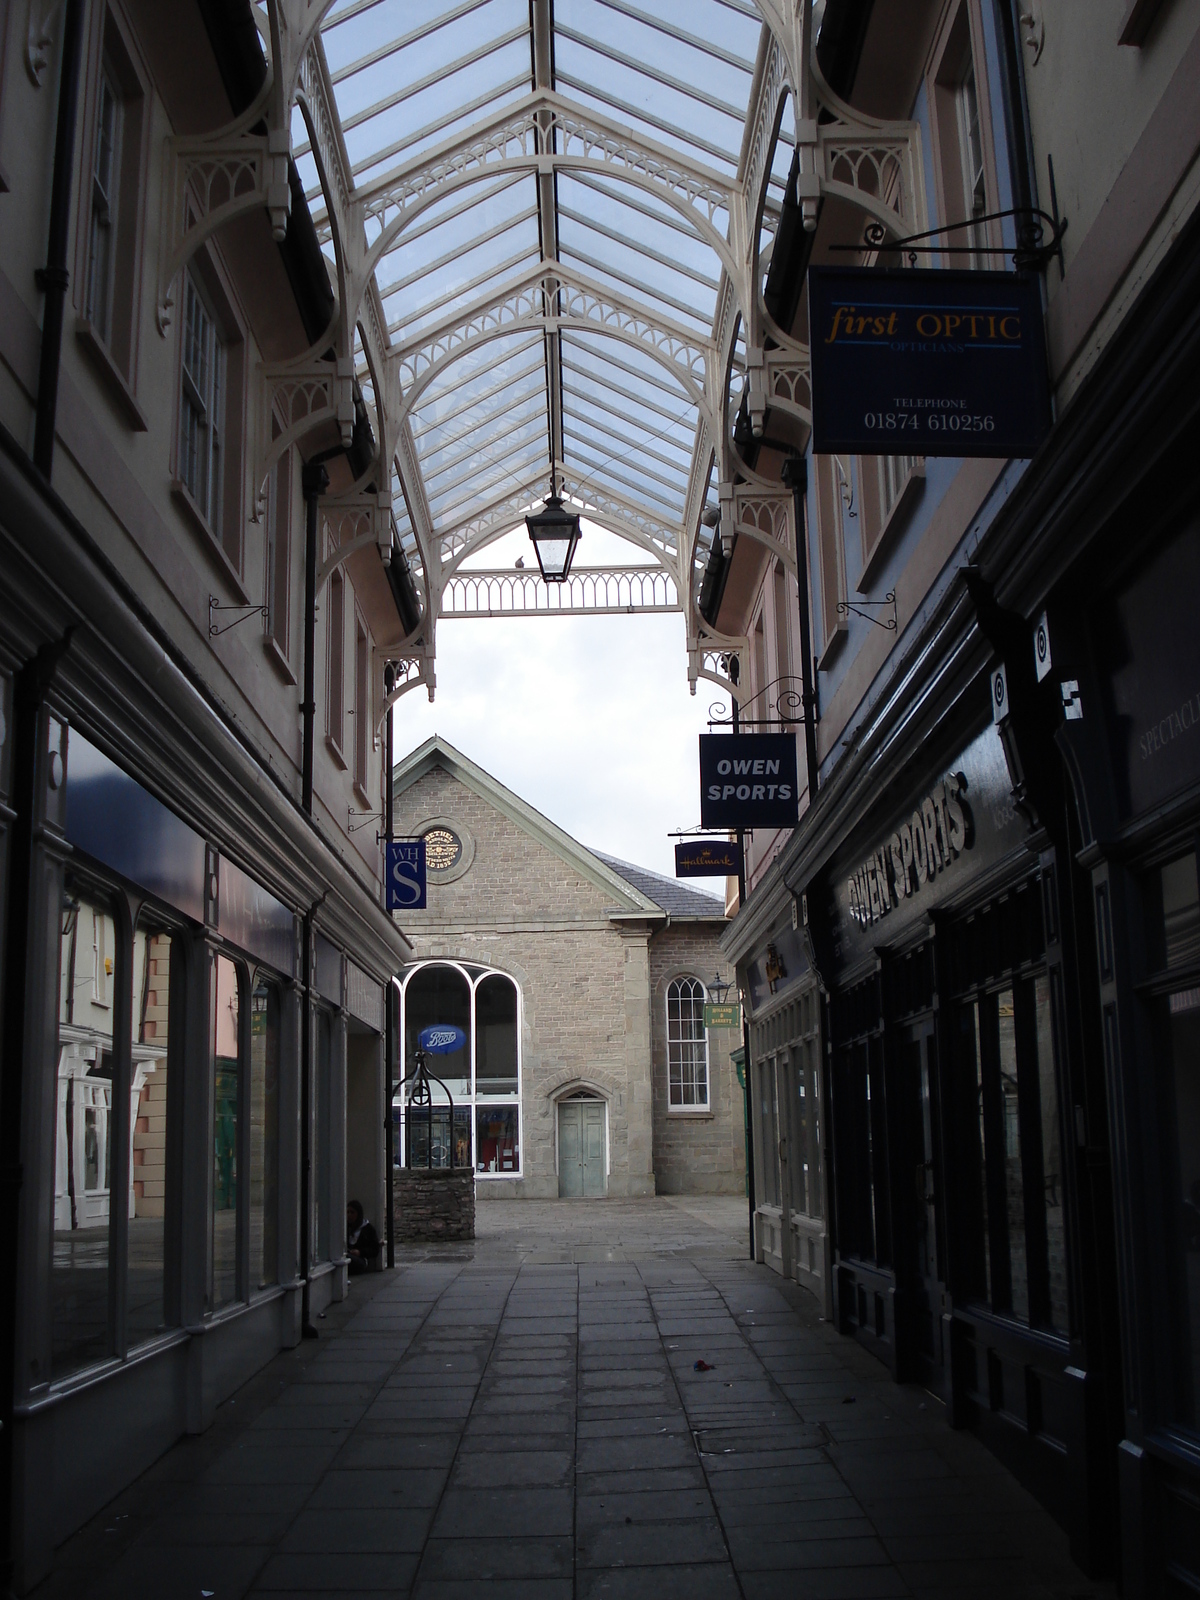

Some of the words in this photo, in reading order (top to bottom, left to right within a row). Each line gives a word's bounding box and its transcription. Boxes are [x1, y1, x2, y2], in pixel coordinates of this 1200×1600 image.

[825, 306, 899, 344] first
[916, 313, 1022, 340] OPTIC
[890, 341, 965, 354] OPTICIANS
[893, 398, 967, 409] TELEPHONE
[864, 413, 920, 430] 01874
[928, 414, 995, 432] 610256
[716, 759, 780, 775] OWEN
[707, 784, 792, 801] SPORTS
[424, 831, 454, 842] BETHEL
[391, 848, 419, 861] WH
[847, 845, 891, 925] OWEN
[889, 771, 967, 900] SPORTS
[680, 854, 735, 870] Hallmark
[392, 860, 421, 905] S
[426, 1031, 457, 1048] Boots
